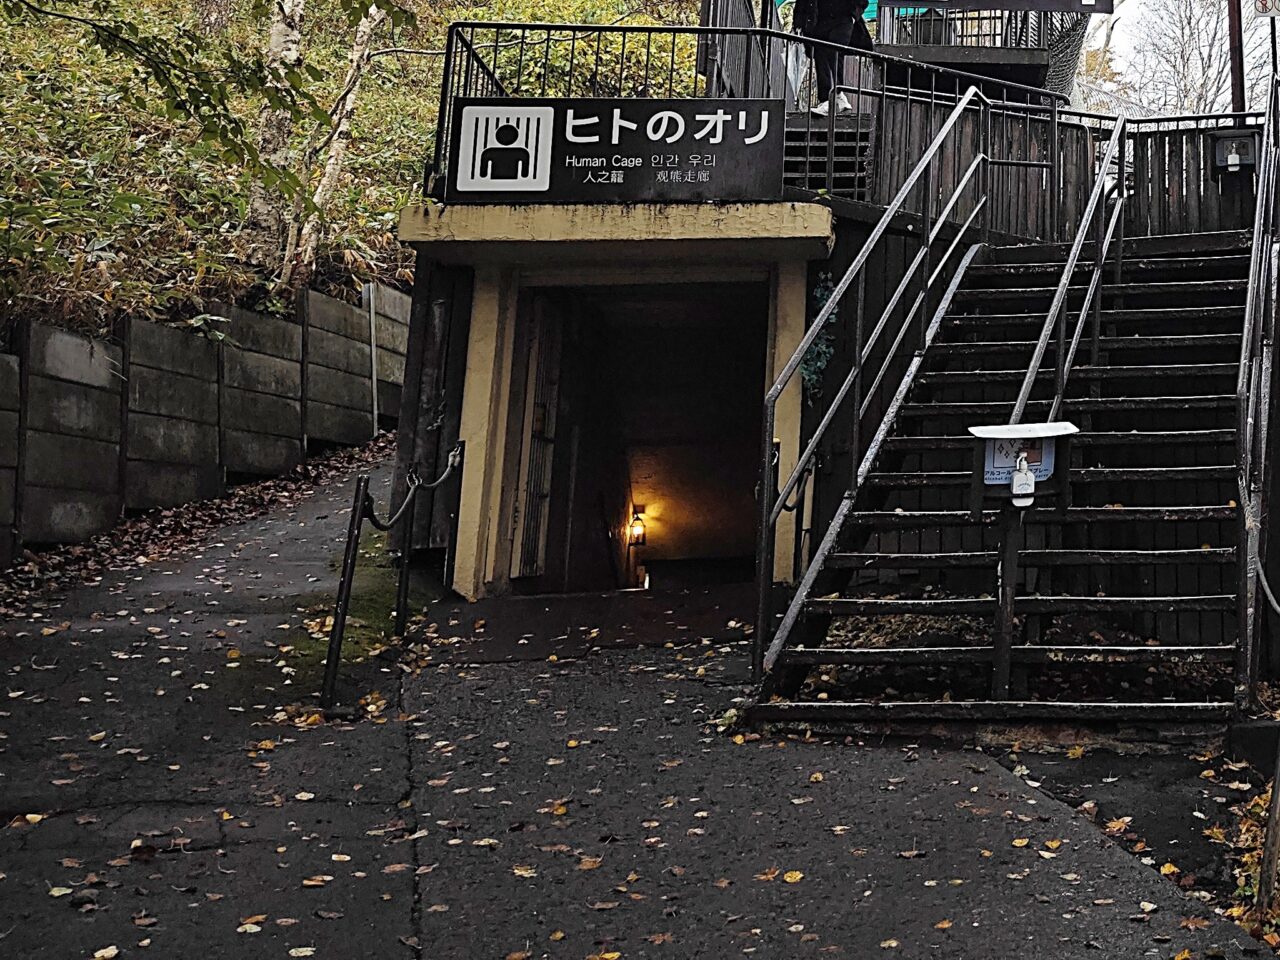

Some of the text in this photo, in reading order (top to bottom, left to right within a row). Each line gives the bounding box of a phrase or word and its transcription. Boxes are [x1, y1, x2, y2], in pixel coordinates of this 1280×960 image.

[565, 108, 769, 145] ヒトのオリ
[565, 154, 643, 168] Human Cage
[651, 154, 716, 167] 인간 우리
[655, 170, 710, 183] 观熊走廊
